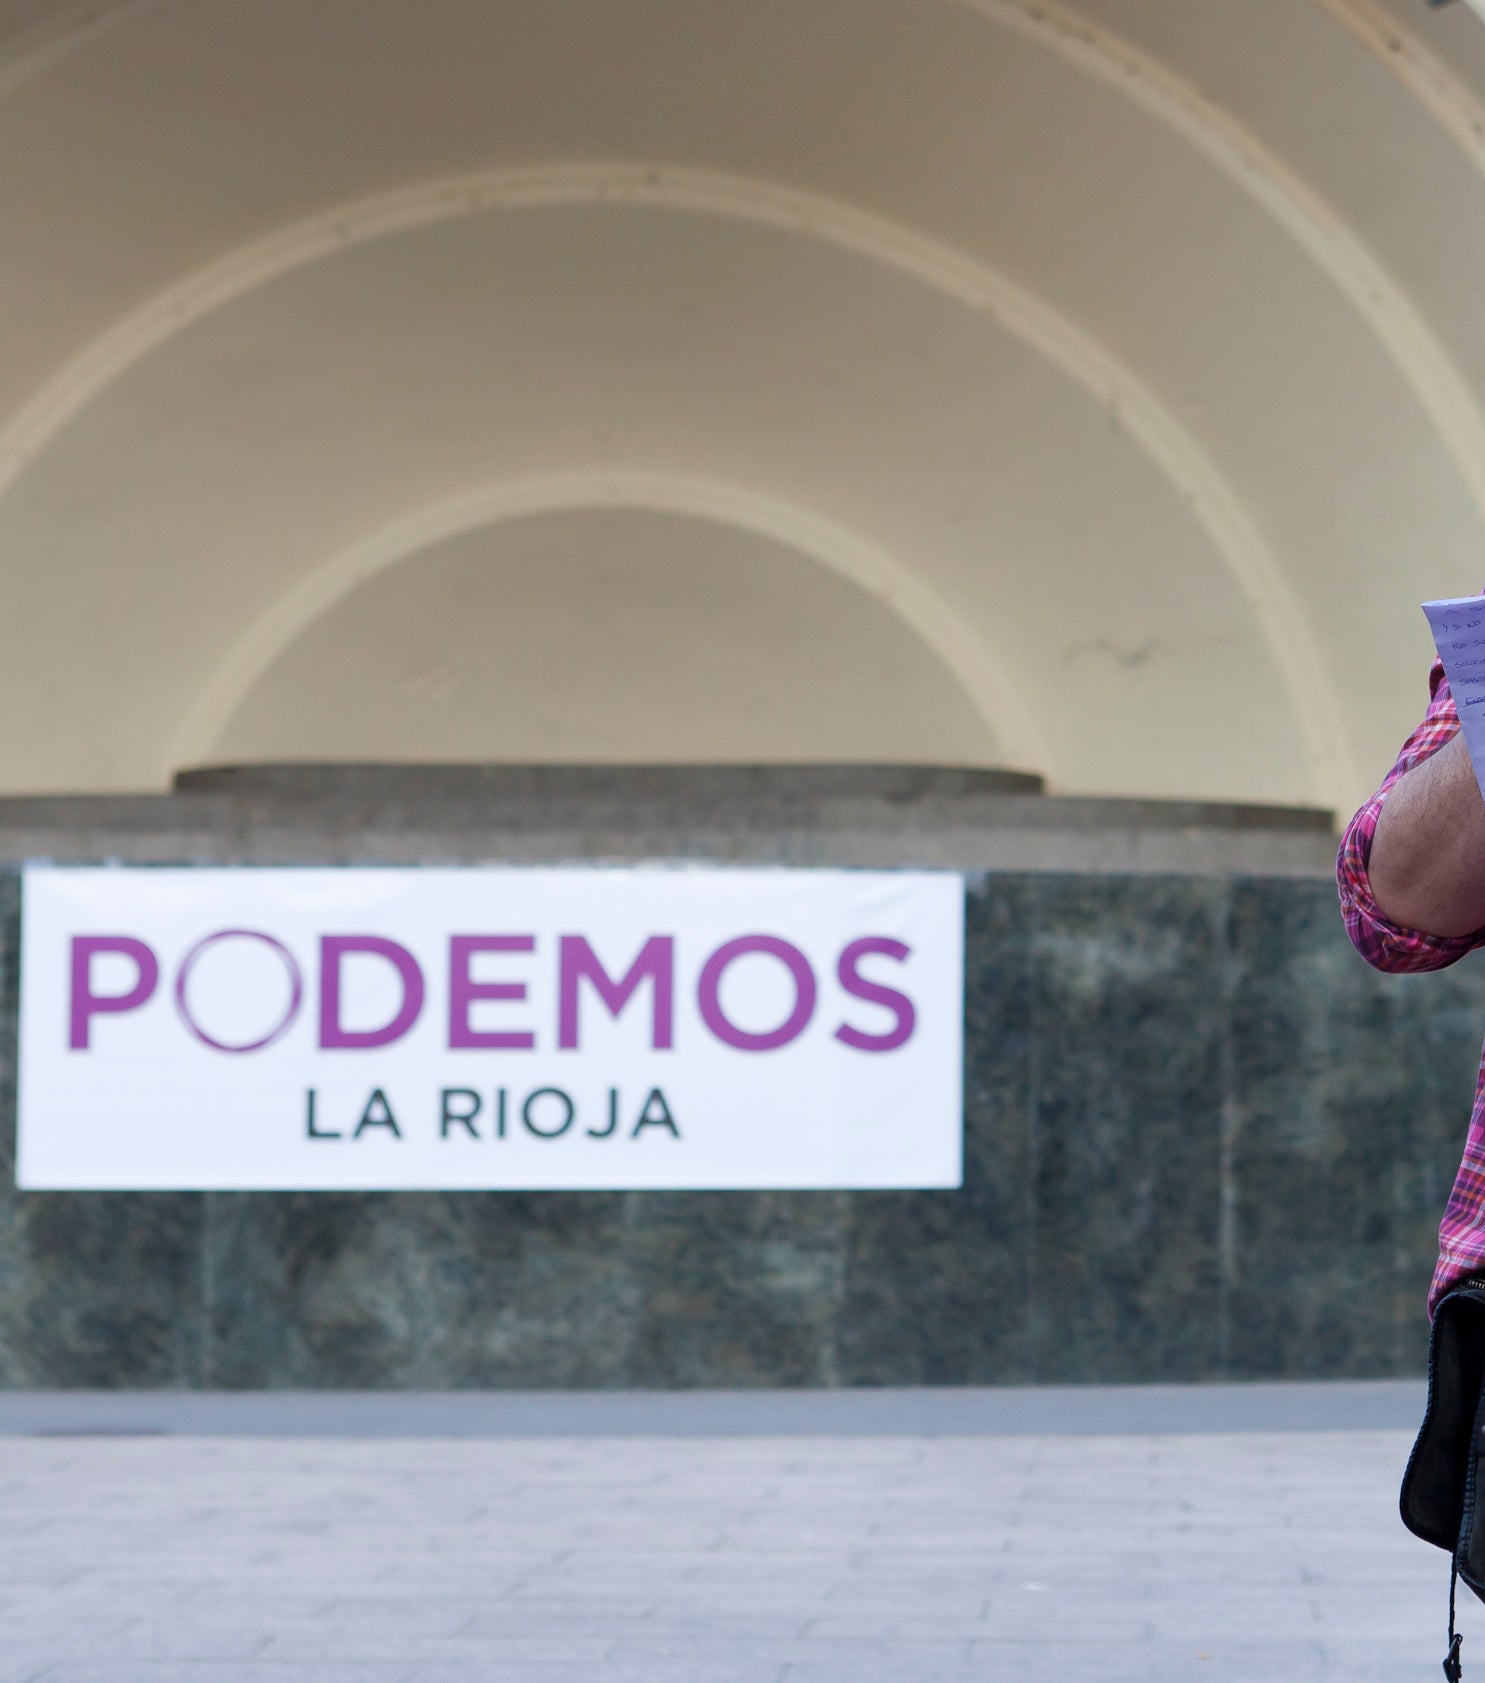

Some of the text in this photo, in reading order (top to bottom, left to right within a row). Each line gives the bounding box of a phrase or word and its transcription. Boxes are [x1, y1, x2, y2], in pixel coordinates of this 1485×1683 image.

[69, 928, 916, 1053] PODEMOS
[305, 1087, 681, 1140] LA RIOJA
